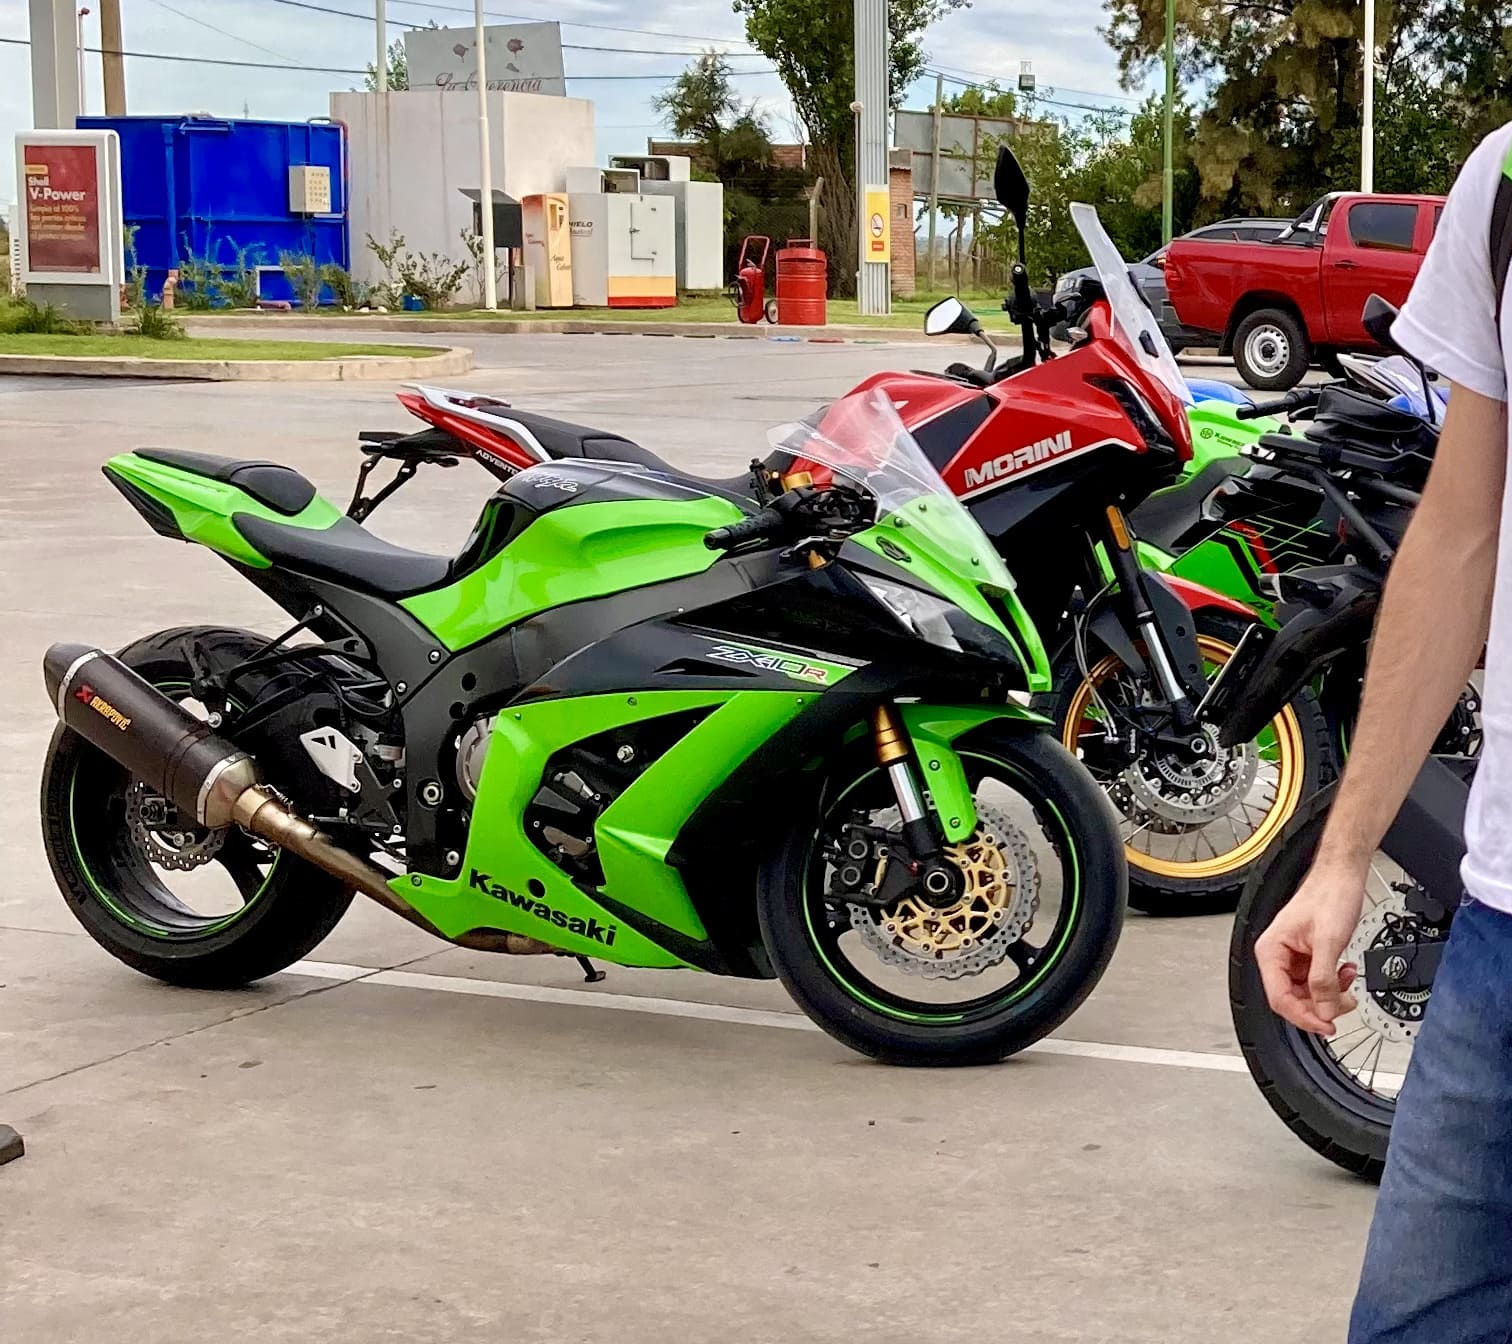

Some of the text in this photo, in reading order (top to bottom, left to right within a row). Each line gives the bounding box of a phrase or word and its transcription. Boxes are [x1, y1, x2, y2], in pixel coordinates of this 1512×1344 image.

[28, 176, 50, 186] Shell
[29, 187, 86, 201] V-Power
[963, 429, 1073, 489] MORINI
[469, 867, 617, 947] Kawasaki
